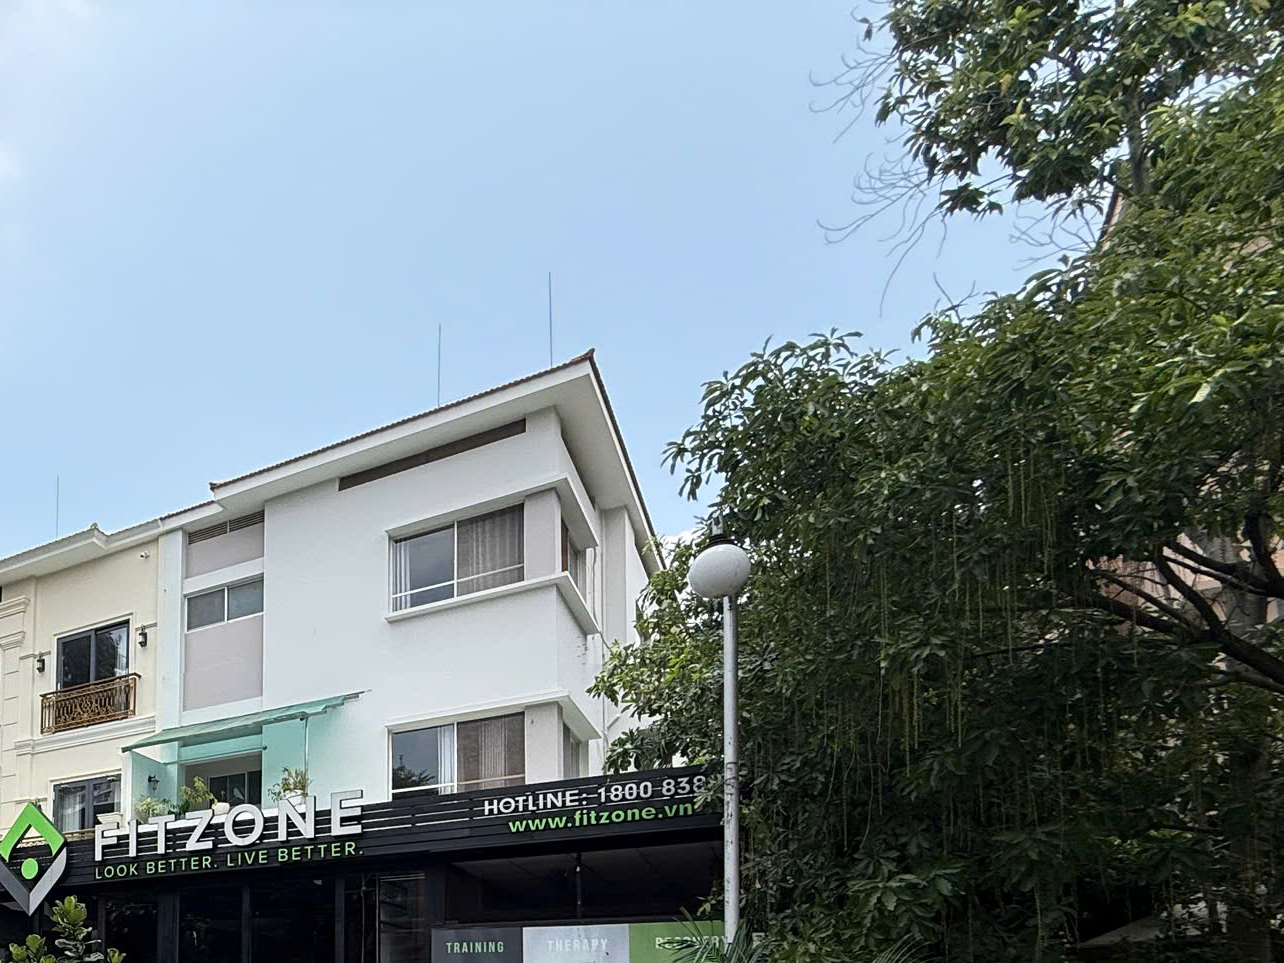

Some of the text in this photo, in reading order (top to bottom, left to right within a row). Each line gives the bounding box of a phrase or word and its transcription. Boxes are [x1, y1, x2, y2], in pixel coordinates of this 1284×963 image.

[484, 789, 588, 816] HOTLINE:
[598, 780, 653, 803] 1800
[94, 789, 364, 862] FITZONE
[508, 802, 693, 832] www.fitzone.vn
[95, 841, 364, 880] LOOK BETTER. LIVE BETTER.
[446, 941, 505, 954] TRAINING
[547, 938, 608, 952] THERAPY
